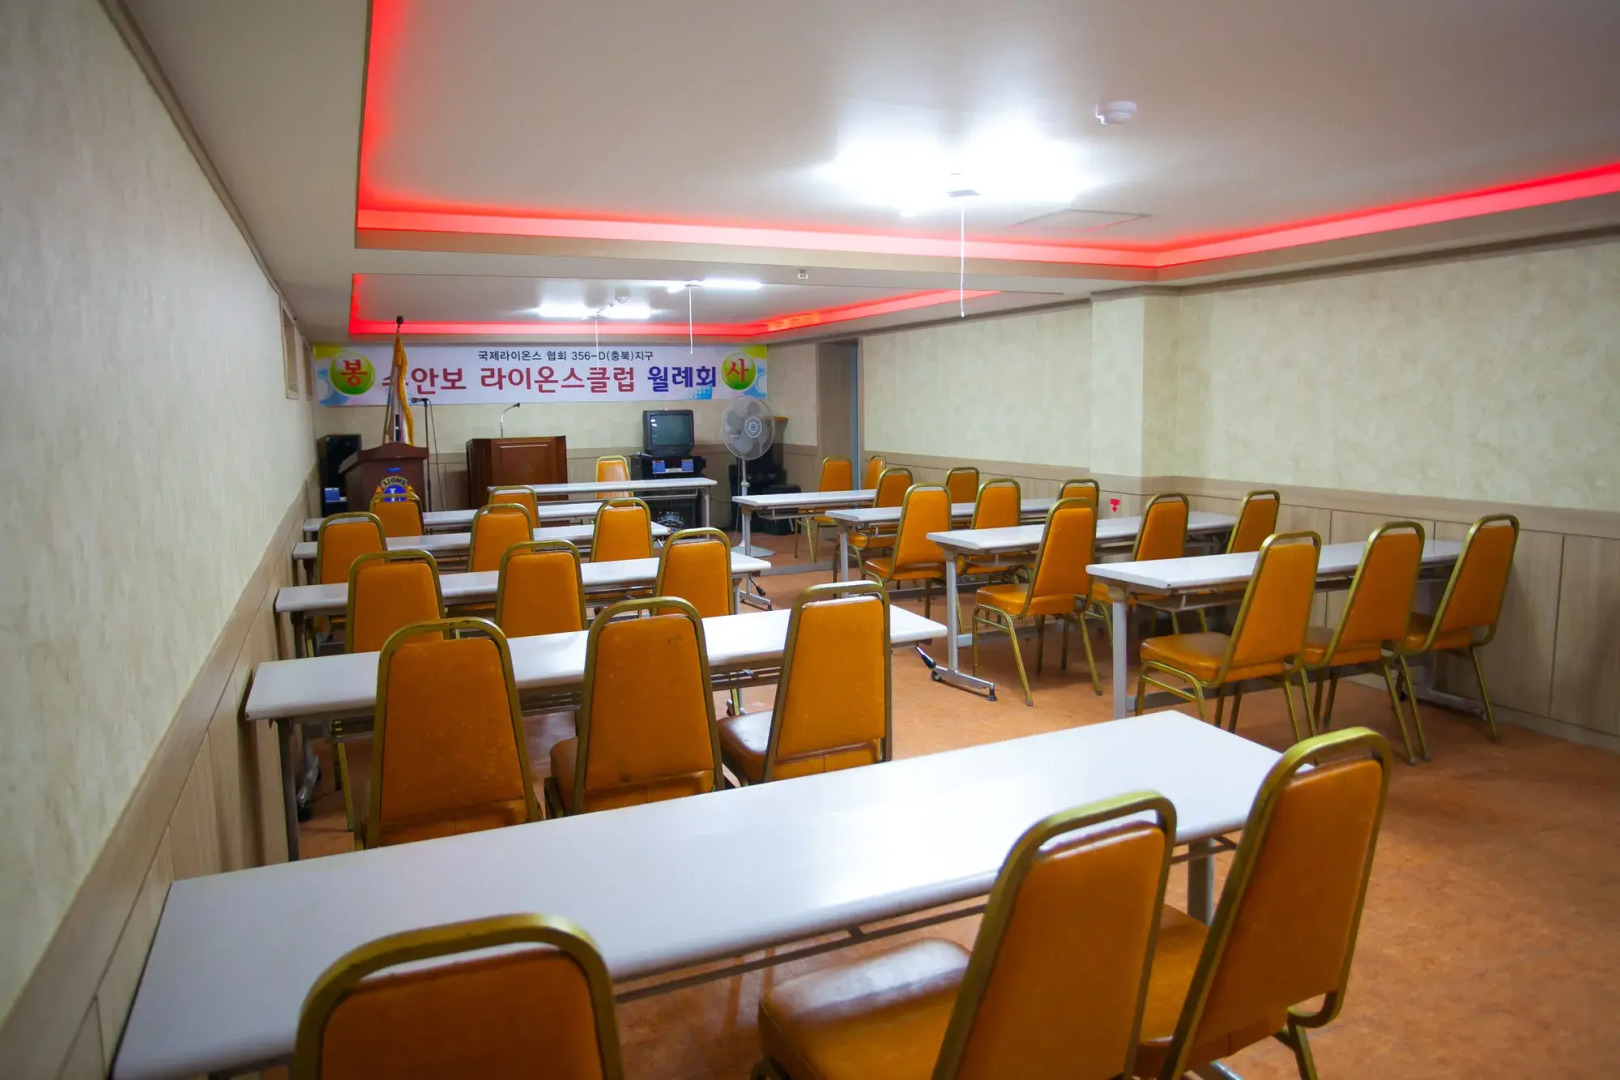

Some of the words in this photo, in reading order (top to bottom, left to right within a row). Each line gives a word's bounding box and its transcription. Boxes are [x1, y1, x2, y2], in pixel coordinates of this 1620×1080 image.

[478, 350, 542, 361] 국제라이온스
[546, 350, 567, 361] 협회
[571, 350, 654, 362] 356-D(충북)지구
[339, 359, 368, 387] 봉
[480, 366, 635, 394] 라이온스클럽
[647, 365, 717, 393] 월례회
[726, 357, 750, 383] 사
[383, 477, 407, 486] LIONS
